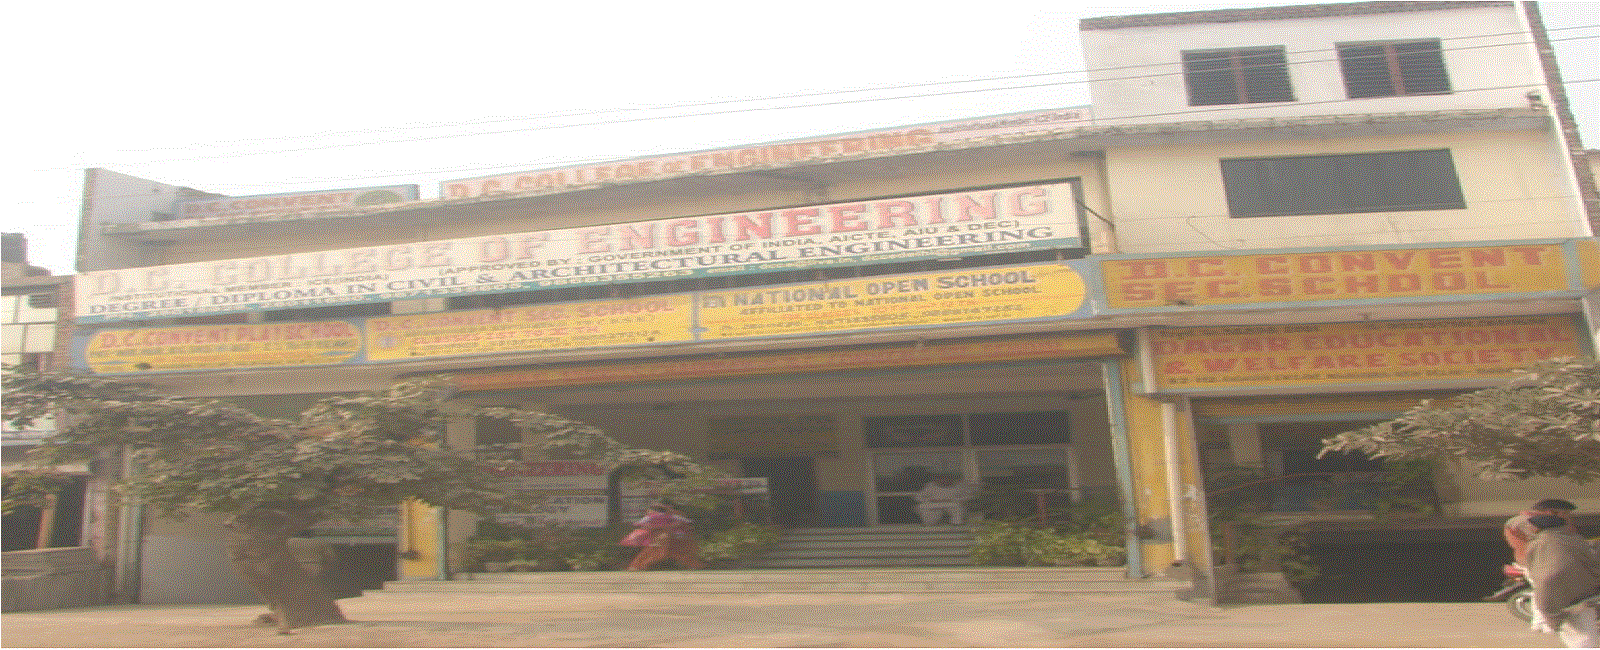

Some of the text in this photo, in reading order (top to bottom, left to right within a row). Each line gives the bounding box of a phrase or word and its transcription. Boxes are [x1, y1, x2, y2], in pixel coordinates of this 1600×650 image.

[212, 242, 453, 286] COLLEGE
[480, 232, 550, 263] OF
[577, 188, 1050, 254] ENGINEERING
[547, 257, 571, 267] BY
[588, 246, 718, 263] GOVERNMENT
[730, 243, 755, 252] OF
[904, 227, 938, 237] AIU
[948, 224, 962, 233] &
[89, 298, 187, 315] DEGREE
[211, 286, 336, 306] DIPLOMA
[346, 284, 376, 295] IN
[385, 275, 465, 292] CIVIL
[475, 272, 495, 284] &
[511, 250, 788, 282] ARCHITECTURAL
[799, 226, 1053, 258] ENGINEERING
[1256, 247, 1548, 275] CONVENT
[733, 270, 1036, 306] NATIONAL OPEN SCHOOL
[1259, 270, 1513, 297] SCHOOL
[578, 299, 676, 318] SCHOOL
[740, 303, 823, 315] AFFILIATED
[854, 294, 926, 307] NATIONAL
[933, 290, 975, 300] OPEN
[1304, 327, 1571, 350] EDUCATIONAL
[1165, 346, 1556, 374] & WELFARE SOCIETY
